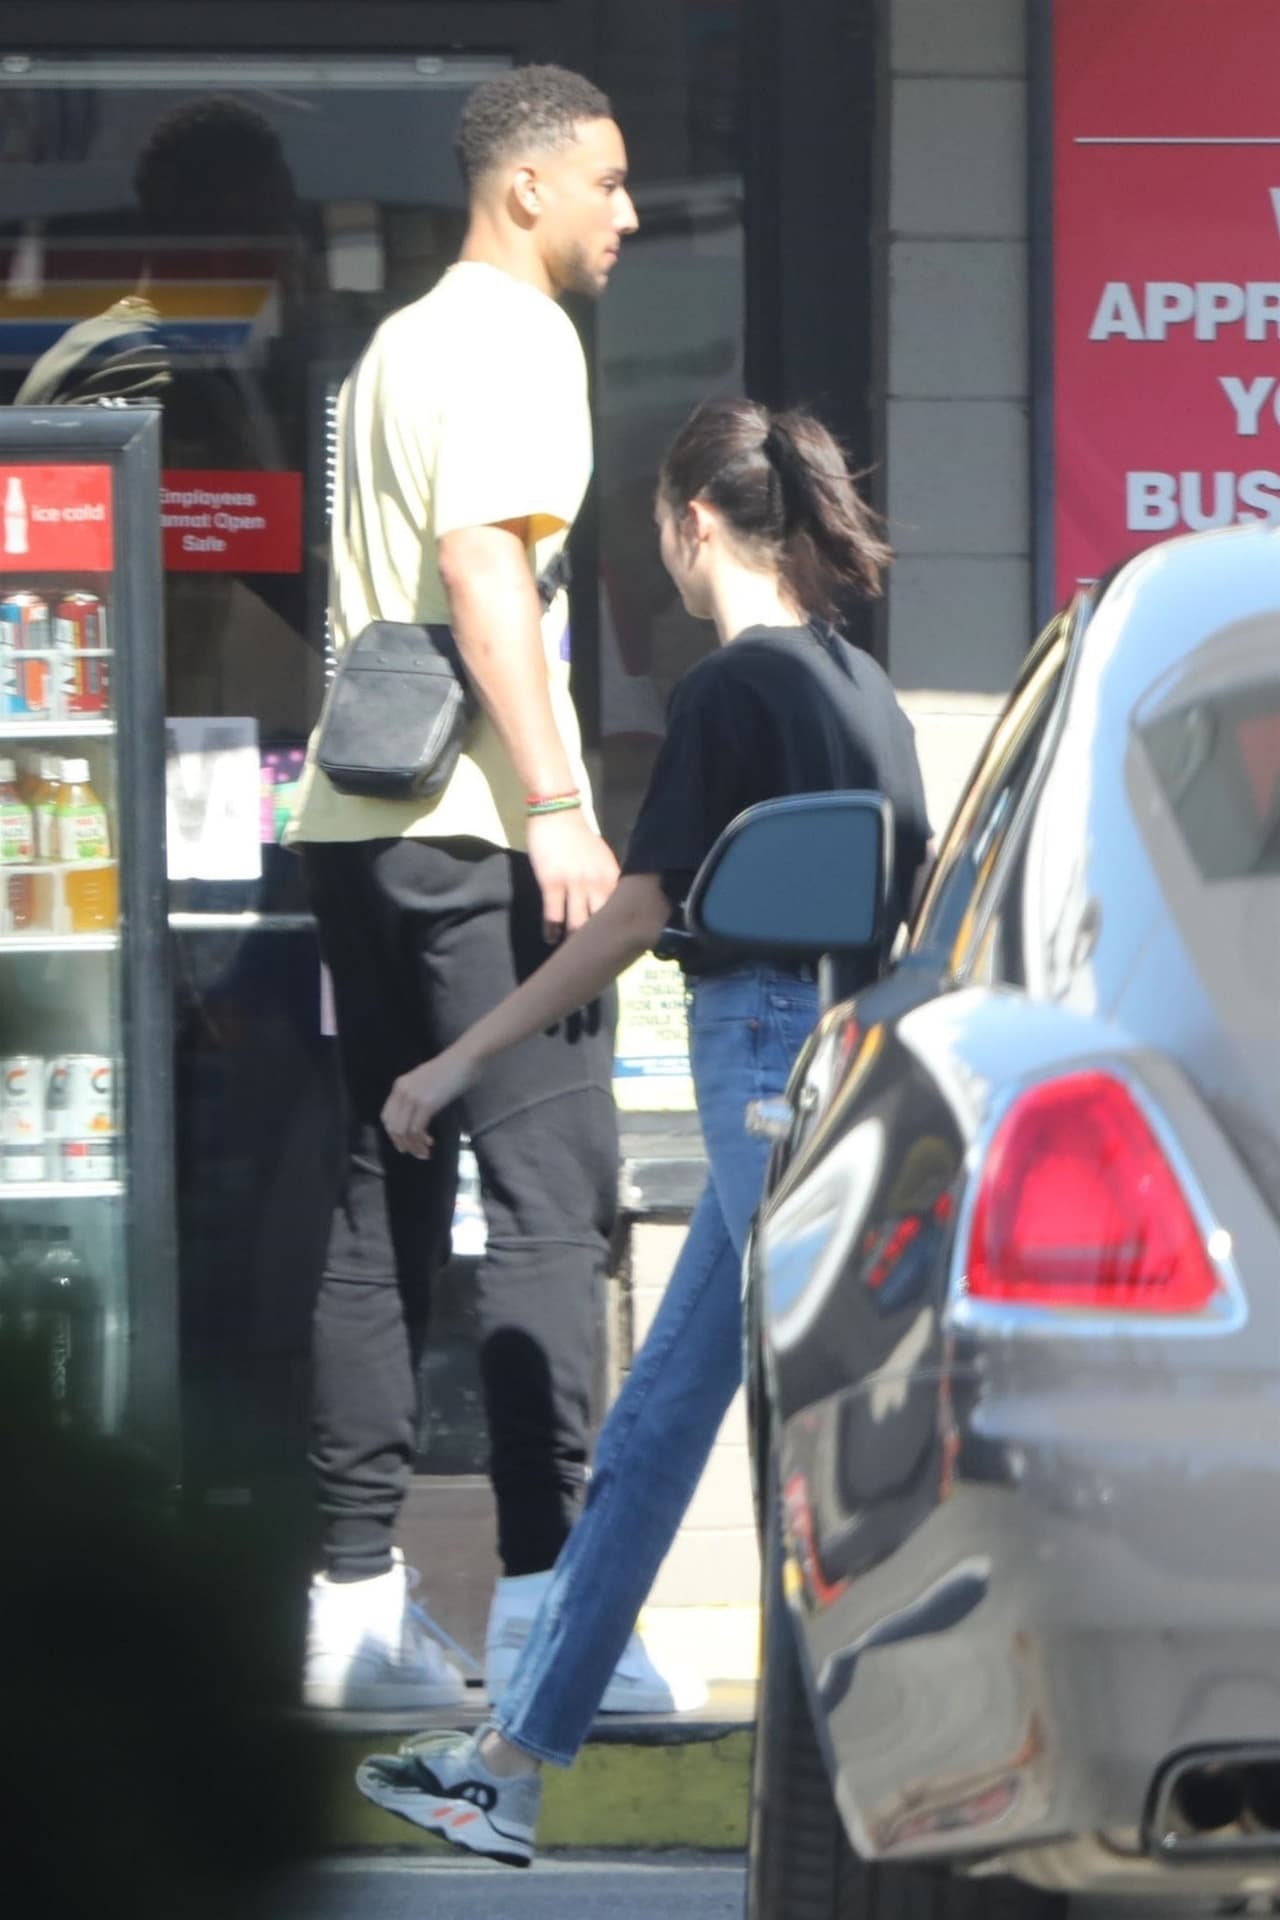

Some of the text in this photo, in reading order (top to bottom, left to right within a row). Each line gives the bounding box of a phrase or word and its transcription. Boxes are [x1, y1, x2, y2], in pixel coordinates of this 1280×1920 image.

[1088, 281, 1280, 341] APPR
[1217, 376, 1280, 436] Y
[32, 503, 105, 522] ice cold
[1125, 470, 1280, 532] BUS
[213, 512, 266, 532] Open
[182, 534, 226, 552] Safe
